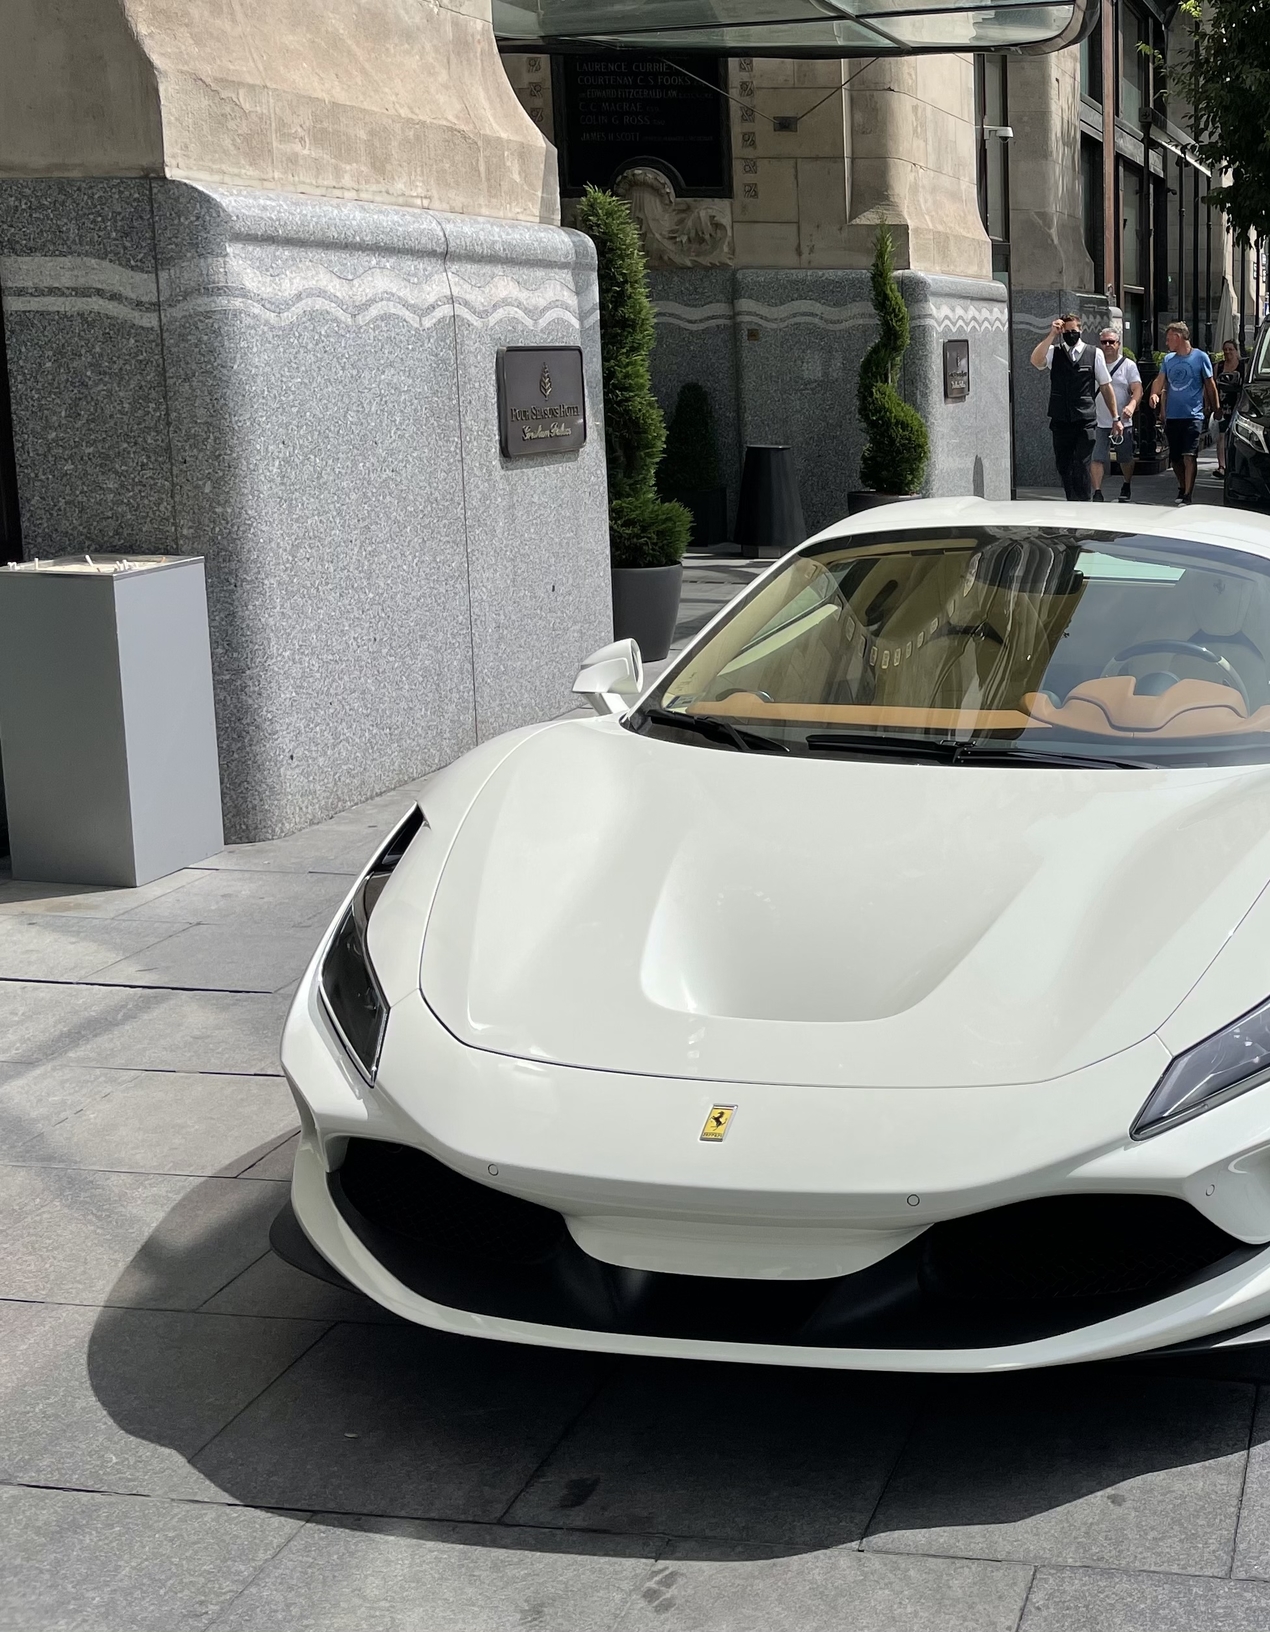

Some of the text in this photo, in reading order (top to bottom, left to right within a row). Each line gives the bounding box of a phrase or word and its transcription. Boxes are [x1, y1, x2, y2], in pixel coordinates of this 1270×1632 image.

[576, 62, 628, 72] LAURENCE
[632, 62, 670, 72] CURRIE
[577, 75, 634, 85] COURTENAY
[657, 75, 691, 85] FOOKS
[586, 89, 617, 98] EDWARD
[663, 89, 678, 98] LAW
[601, 102, 643, 112] MACRAE
[580, 115, 608, 125] COLIN
[623, 115, 650, 125] ROSS
[581, 132, 606, 141] JAMES
[616, 132, 640, 141] SCOTT
